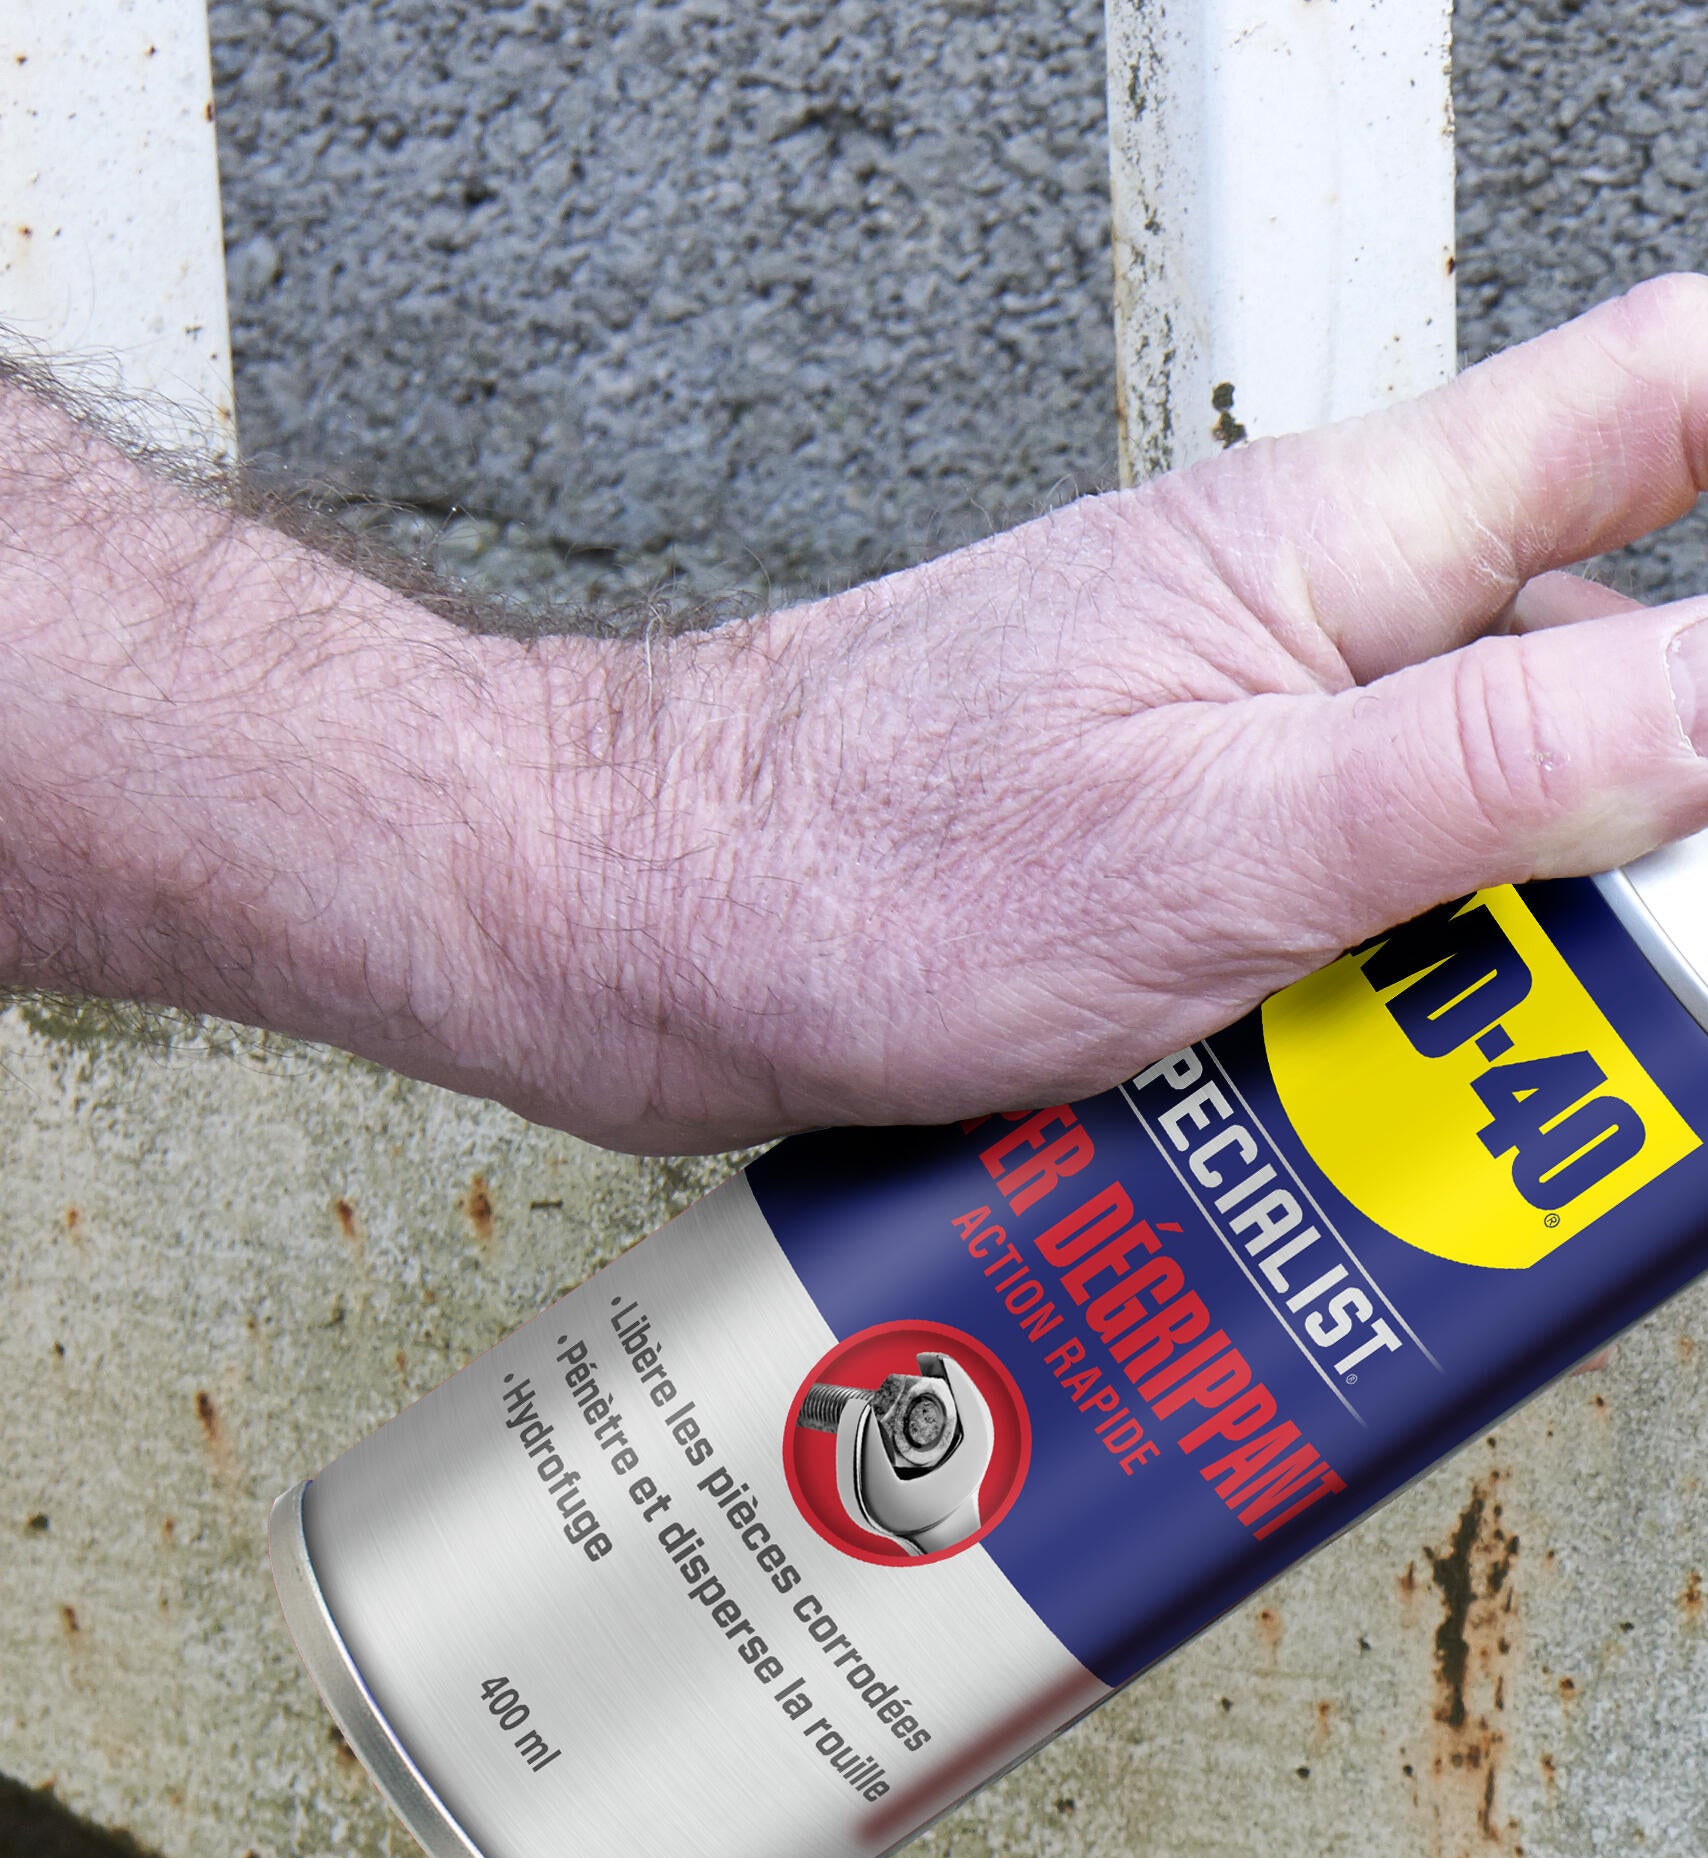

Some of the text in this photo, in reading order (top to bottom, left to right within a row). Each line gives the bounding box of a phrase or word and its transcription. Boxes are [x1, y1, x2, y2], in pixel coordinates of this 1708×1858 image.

[951, 1205, 1161, 1476] ACTION RAPIDE
[1033, 1181, 1348, 1542] DÉGRIPPANT
[1132, 1046, 1403, 1376] PECIALIST
[502, 1378, 613, 1563] Hydrofuge
[556, 1339, 891, 1803] Pénètre et disperse la rouille
[610, 1301, 932, 1752] Libère les pièces corrodées
[480, 1676, 562, 1773] 400 ml
